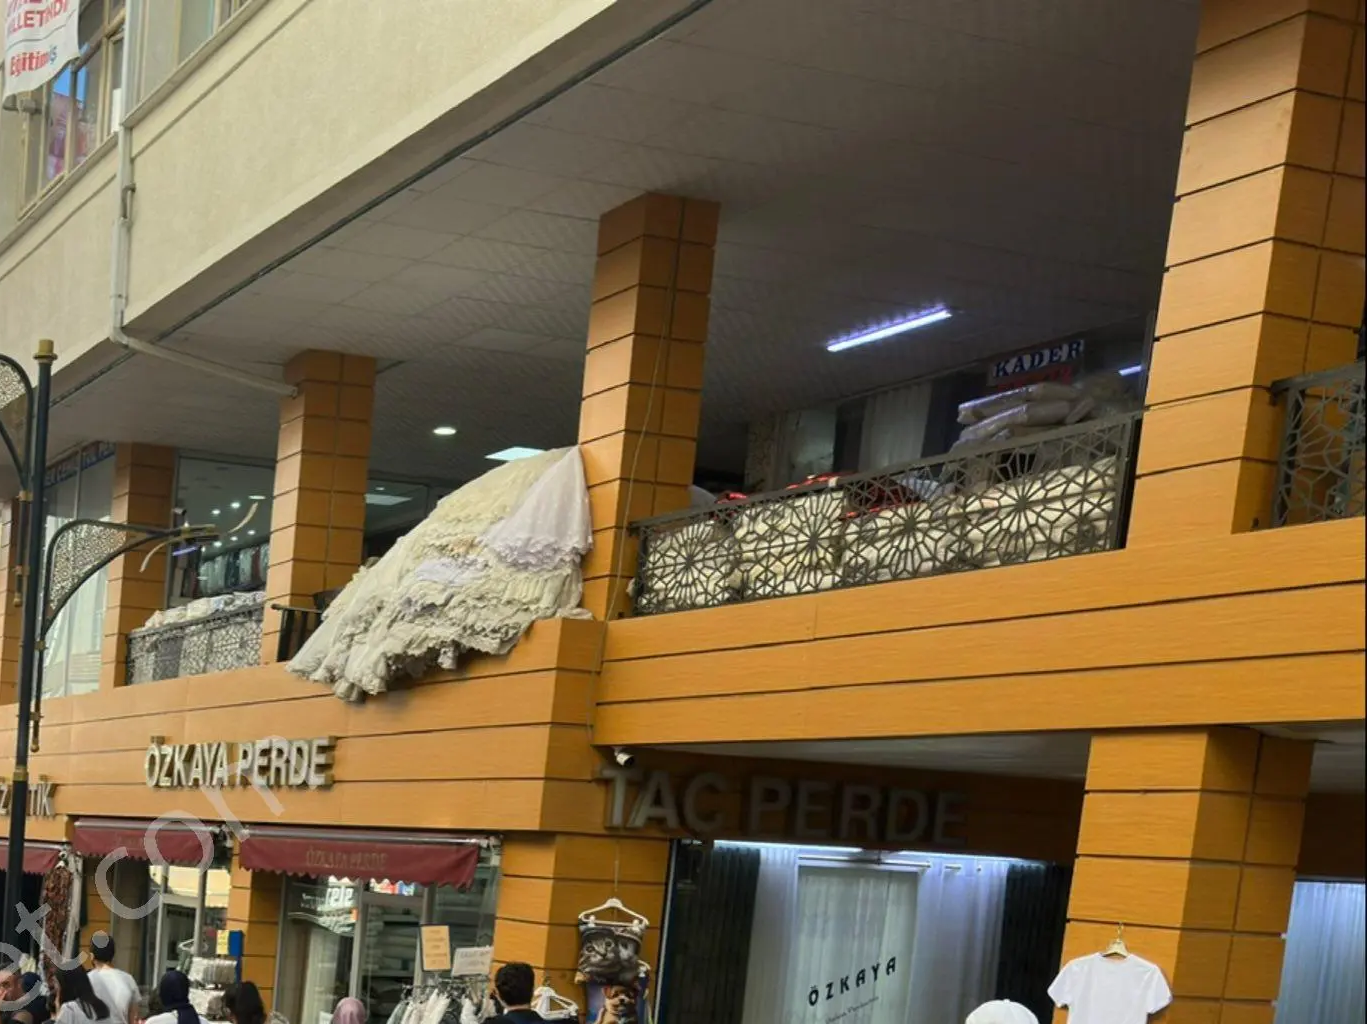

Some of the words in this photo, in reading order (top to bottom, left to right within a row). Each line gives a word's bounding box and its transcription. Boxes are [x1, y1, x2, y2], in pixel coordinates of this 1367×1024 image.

[236, 738, 331, 788] PERDE
[749, 777, 969, 845] PERDE
[808, 955, 896, 1007] ÖZKAYA
